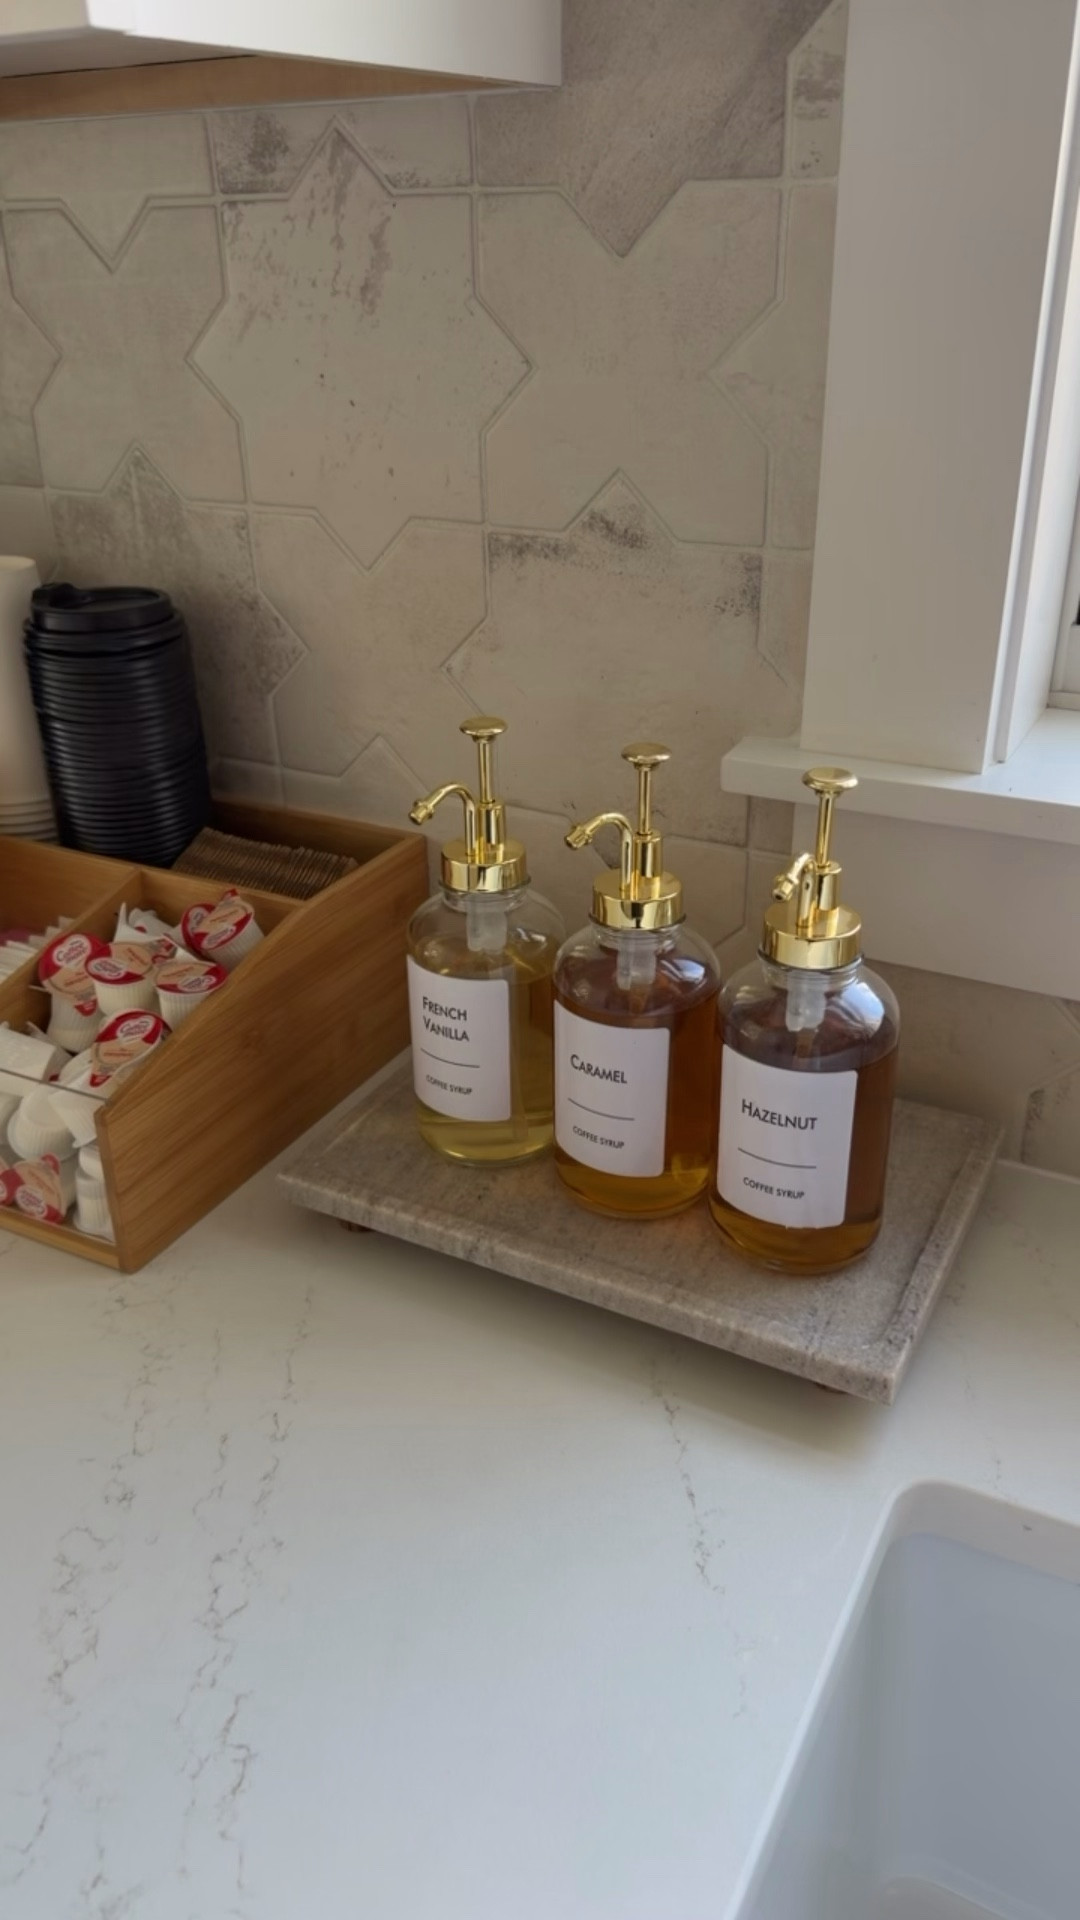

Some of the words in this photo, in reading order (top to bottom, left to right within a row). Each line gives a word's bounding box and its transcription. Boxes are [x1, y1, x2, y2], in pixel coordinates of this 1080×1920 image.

[422, 995, 467, 1021] FRENCH
[422, 1015, 470, 1042] VANILLA
[570, 1053, 628, 1084] CARAMEL
[425, 1074, 448, 1091] COFFEE
[449, 1084, 473, 1095] SYRUP
[741, 1098, 818, 1130] HAZELNUT
[572, 1125, 599, 1144] COFFEE
[599, 1137, 625, 1149] SYRUP
[742, 1176, 774, 1195] COFFEE
[776, 1188, 806, 1199] SYRUP
